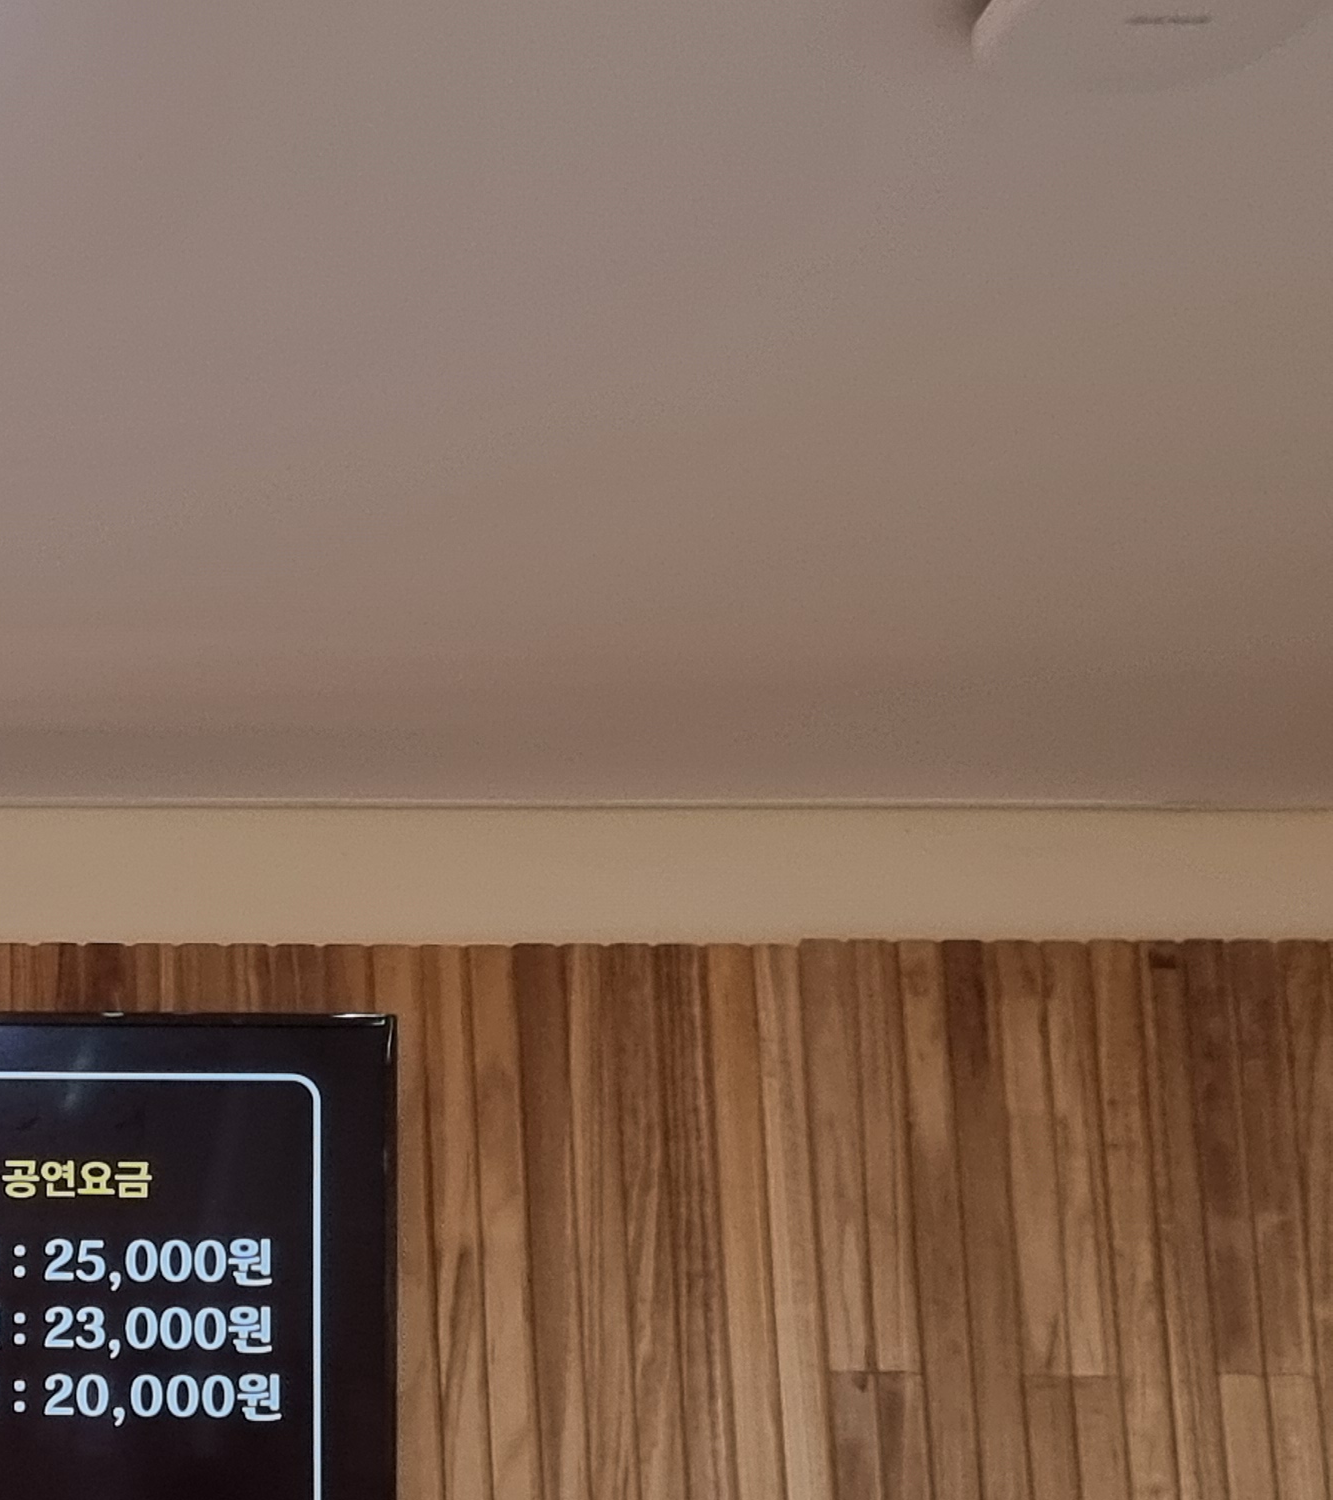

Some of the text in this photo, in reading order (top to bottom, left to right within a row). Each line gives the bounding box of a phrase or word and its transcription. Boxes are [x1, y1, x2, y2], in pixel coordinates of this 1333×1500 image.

[1, 1158, 153, 1199] 공연요금
[43, 1237, 273, 1291] 25,000원
[43, 1304, 273, 1358] 23,000원
[43, 1371, 283, 1426] 20,000원
